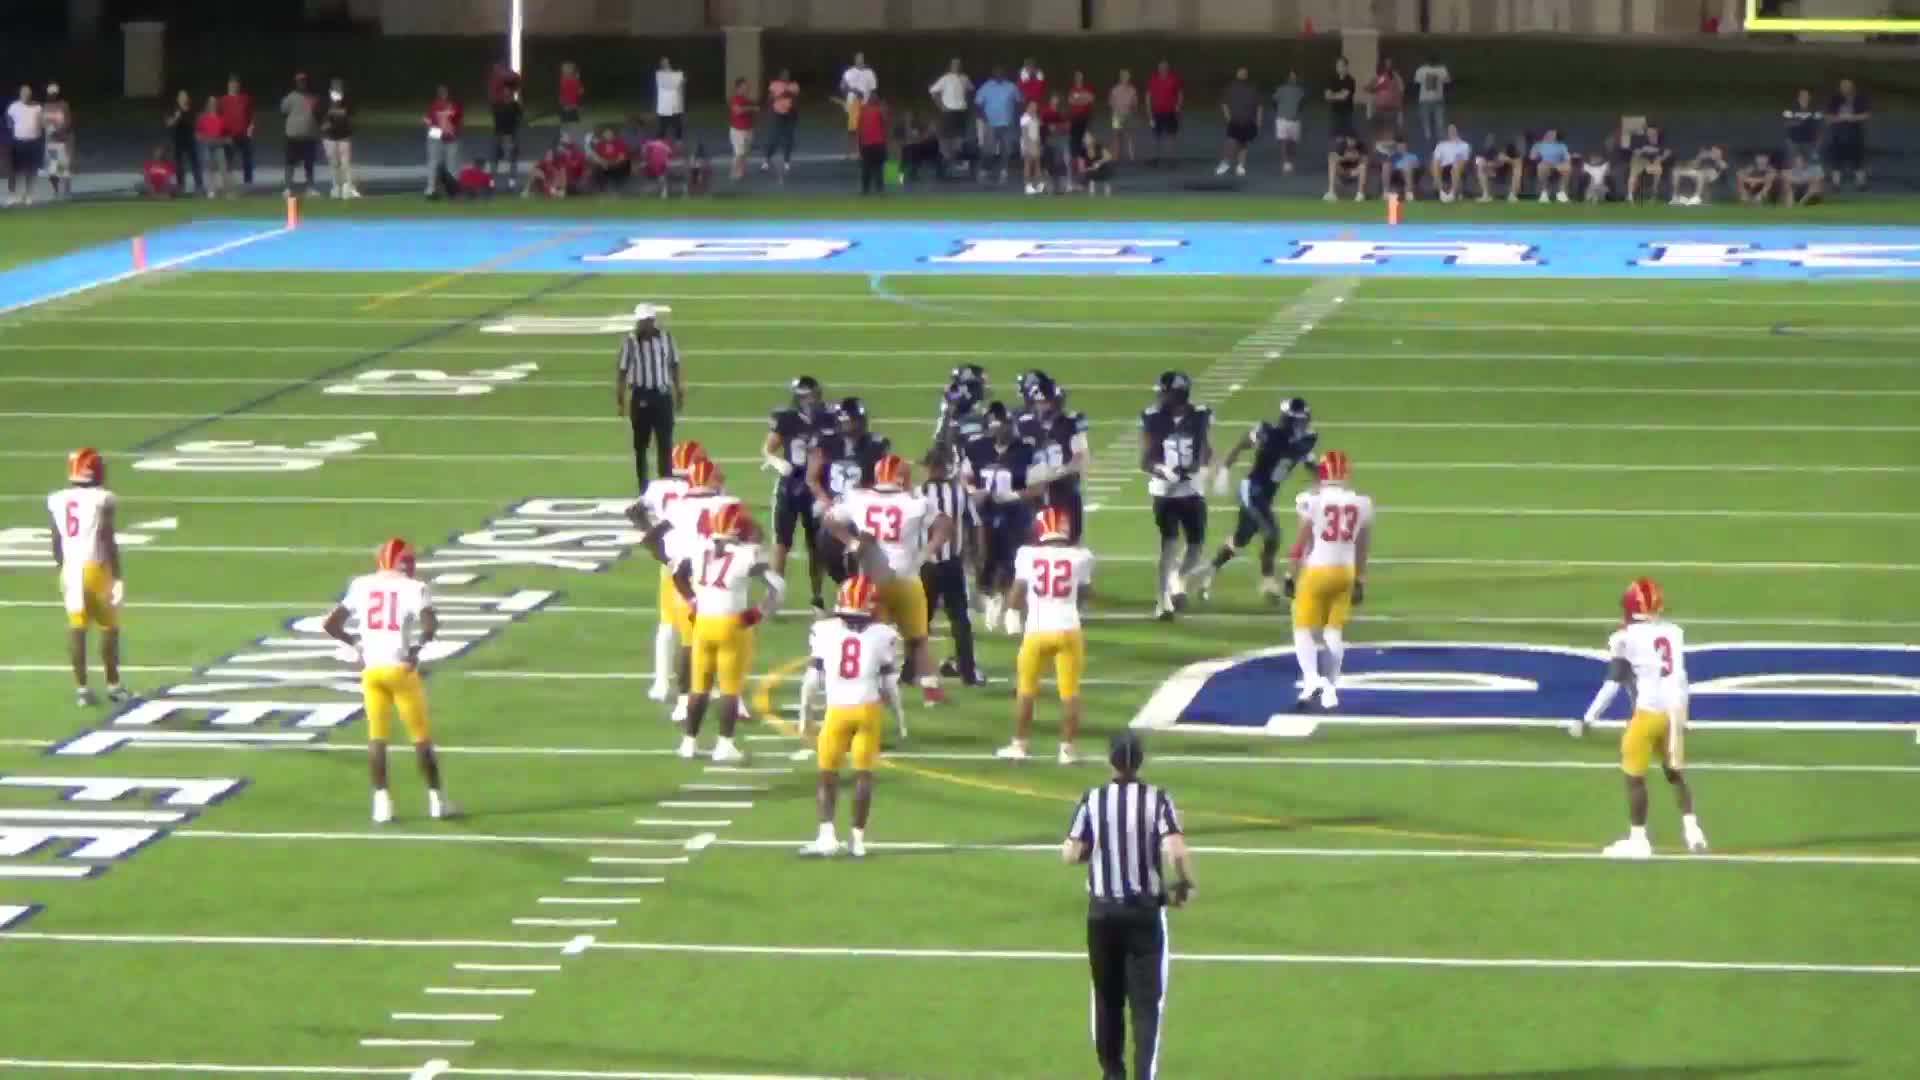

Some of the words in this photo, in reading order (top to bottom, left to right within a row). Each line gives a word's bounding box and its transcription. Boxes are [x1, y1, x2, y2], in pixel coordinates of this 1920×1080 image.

[66, 501, 80, 537] 6
[865, 504, 903, 544] 53
[1321, 504, 1359, 542] 33
[698, 550, 735, 590] 17
[1032, 558, 1072, 598] 32
[367, 591, 401, 631] 21
[839, 636, 862, 679] 8
[1653, 637, 1674, 678] 3
